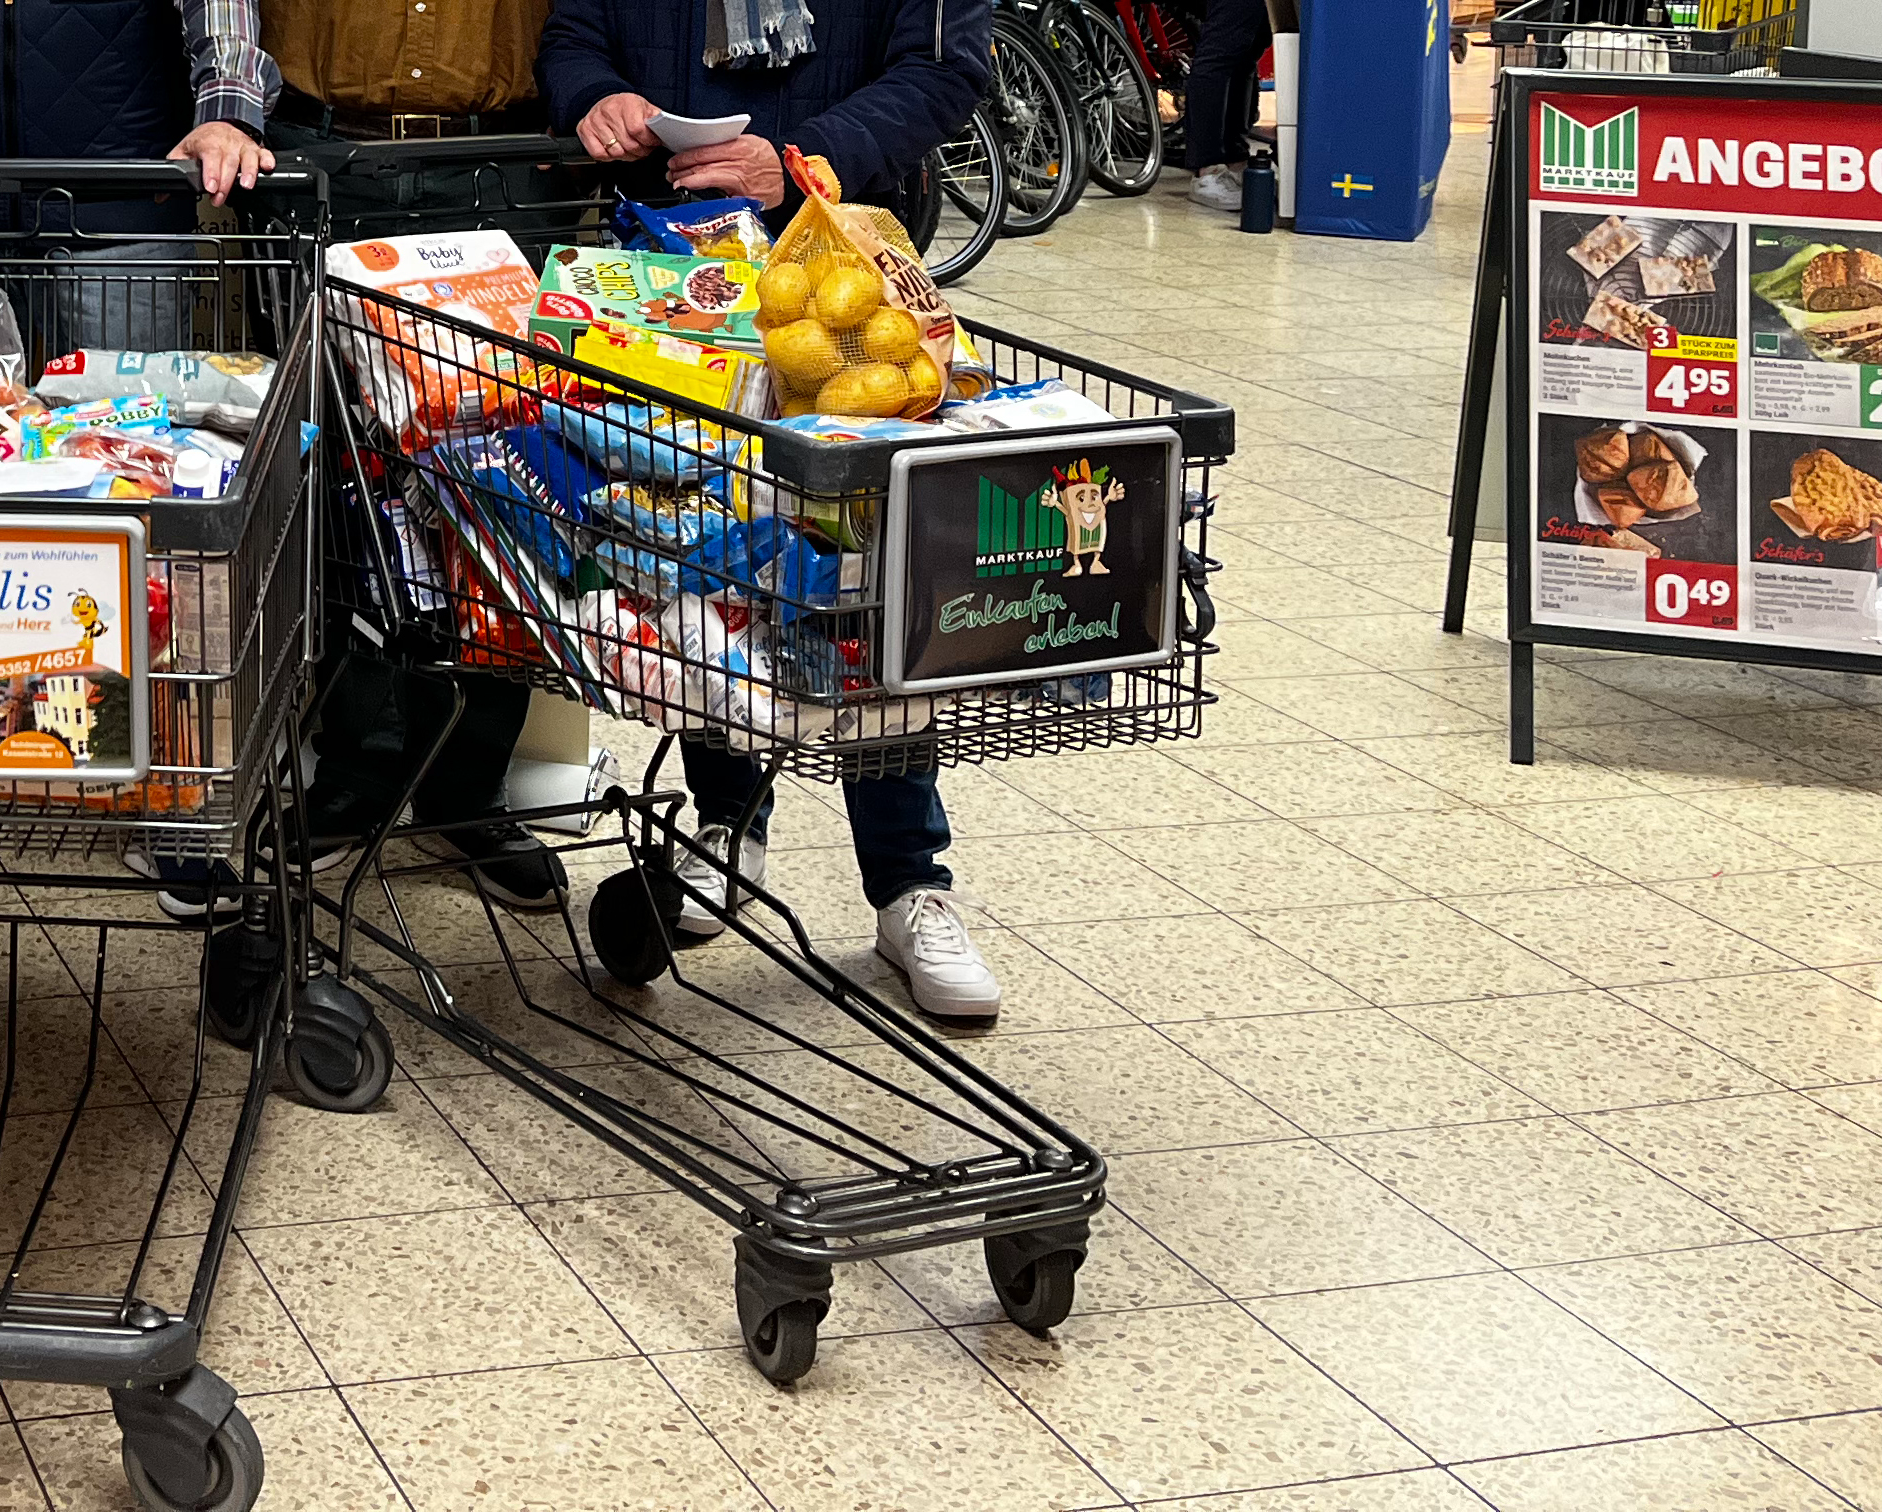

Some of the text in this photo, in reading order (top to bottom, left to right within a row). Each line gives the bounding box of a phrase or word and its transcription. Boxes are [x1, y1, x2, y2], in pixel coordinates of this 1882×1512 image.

[1542, 167, 1636, 180] MARKTKAUF
[416, 246, 464, 262] Baby
[594, 261, 639, 300] CHIPS
[456, 280, 539, 307] WINDELN
[1653, 328, 1669, 348] 3
[1680, 338, 1736, 350] STÜCK ZUM
[1681, 348, 1735, 359] SPARPREIS
[4, 552, 29, 561] zum
[32, 550, 98, 562] Wohlfühlen
[976, 548, 1064, 566] MARKTKAUF
[939, 578, 1067, 634] Einkaufen
[16, 617, 51, 632] Herz
[1023, 601, 1121, 653] erleben!
